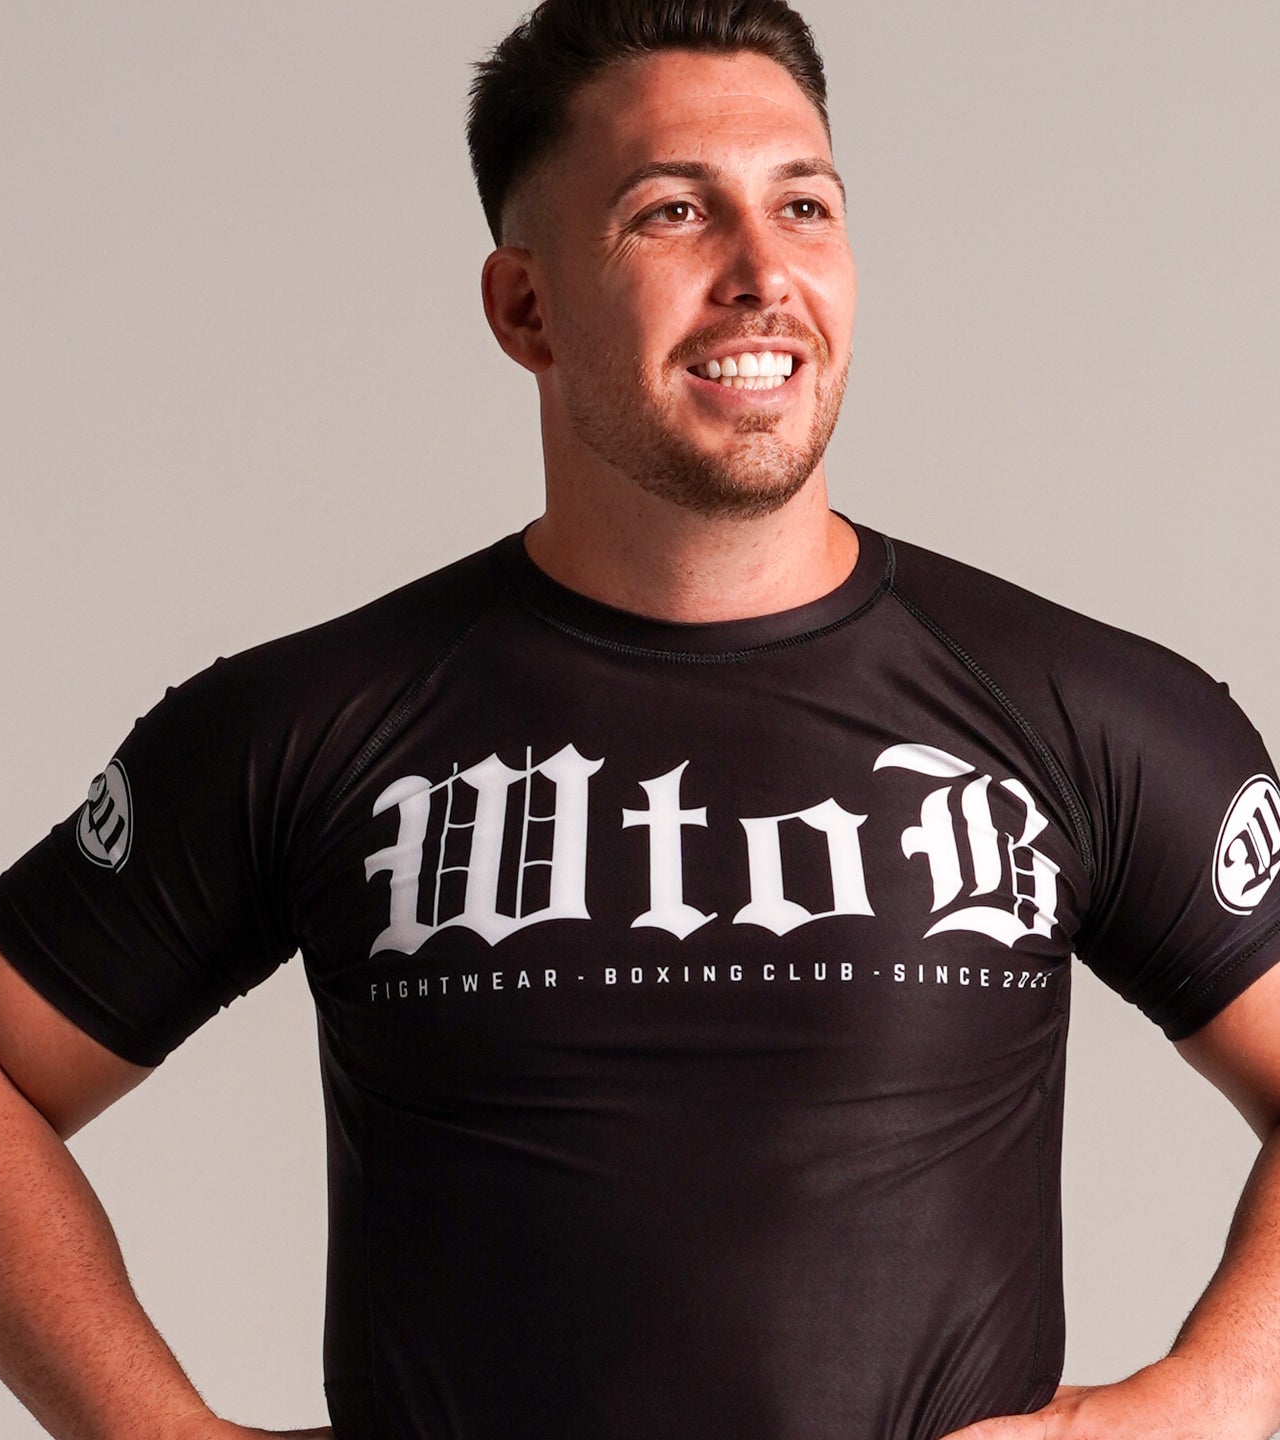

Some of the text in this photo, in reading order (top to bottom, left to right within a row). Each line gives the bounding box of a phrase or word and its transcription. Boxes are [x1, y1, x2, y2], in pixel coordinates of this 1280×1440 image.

[370, 968, 559, 1002] FIGHTWEAR
[605, 962, 745, 985] BOXING
[763, 961, 854, 982] CLUB
[893, 963, 991, 988] SINCE
